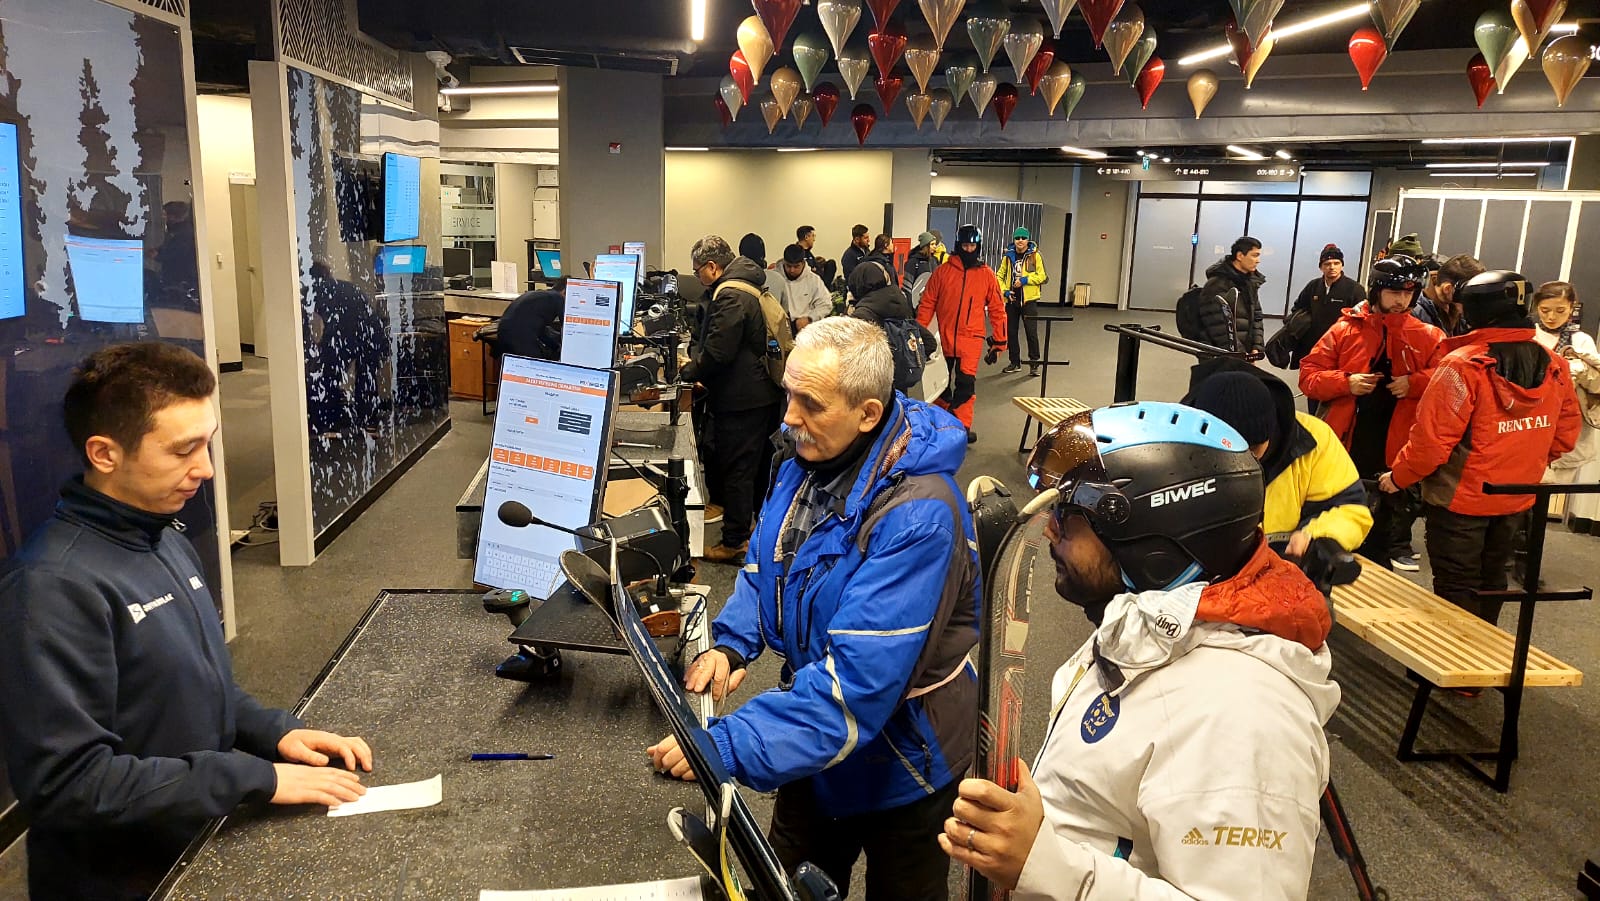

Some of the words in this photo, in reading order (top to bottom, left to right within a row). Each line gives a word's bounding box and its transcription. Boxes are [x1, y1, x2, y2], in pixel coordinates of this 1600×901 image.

[447, 217, 481, 228] ERVICE
[1498, 415, 1551, 434] RENTAL
[1150, 478, 1216, 508] BIWEC
[1155, 616, 1179, 637] Buff
[1181, 838, 1209, 846] adidas
